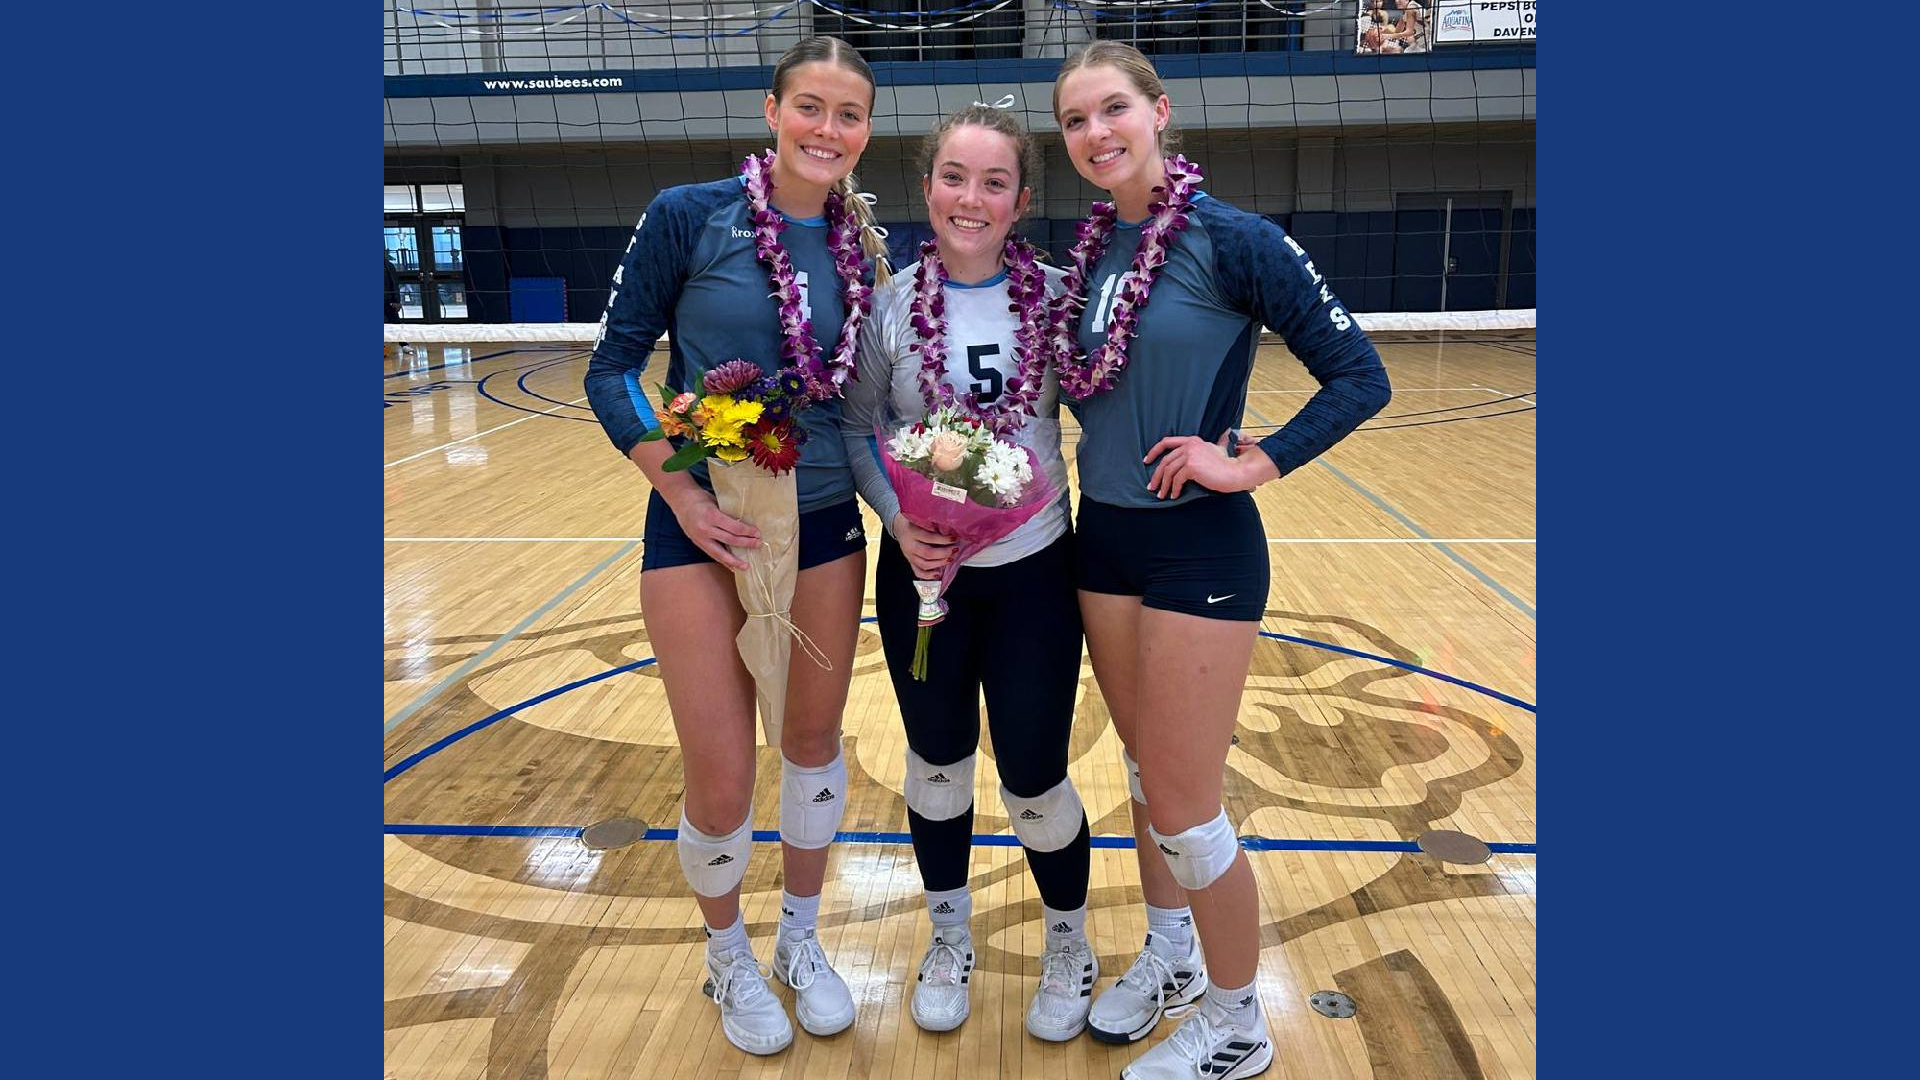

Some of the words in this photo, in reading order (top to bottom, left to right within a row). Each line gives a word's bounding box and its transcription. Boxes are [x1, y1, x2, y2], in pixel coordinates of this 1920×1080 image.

[1480, 2, 1519, 10] PEPSI
[1524, 13, 1536, 23] O
[484, 75, 623, 89] www.saubees.com
[966, 343, 1003, 404] 5
